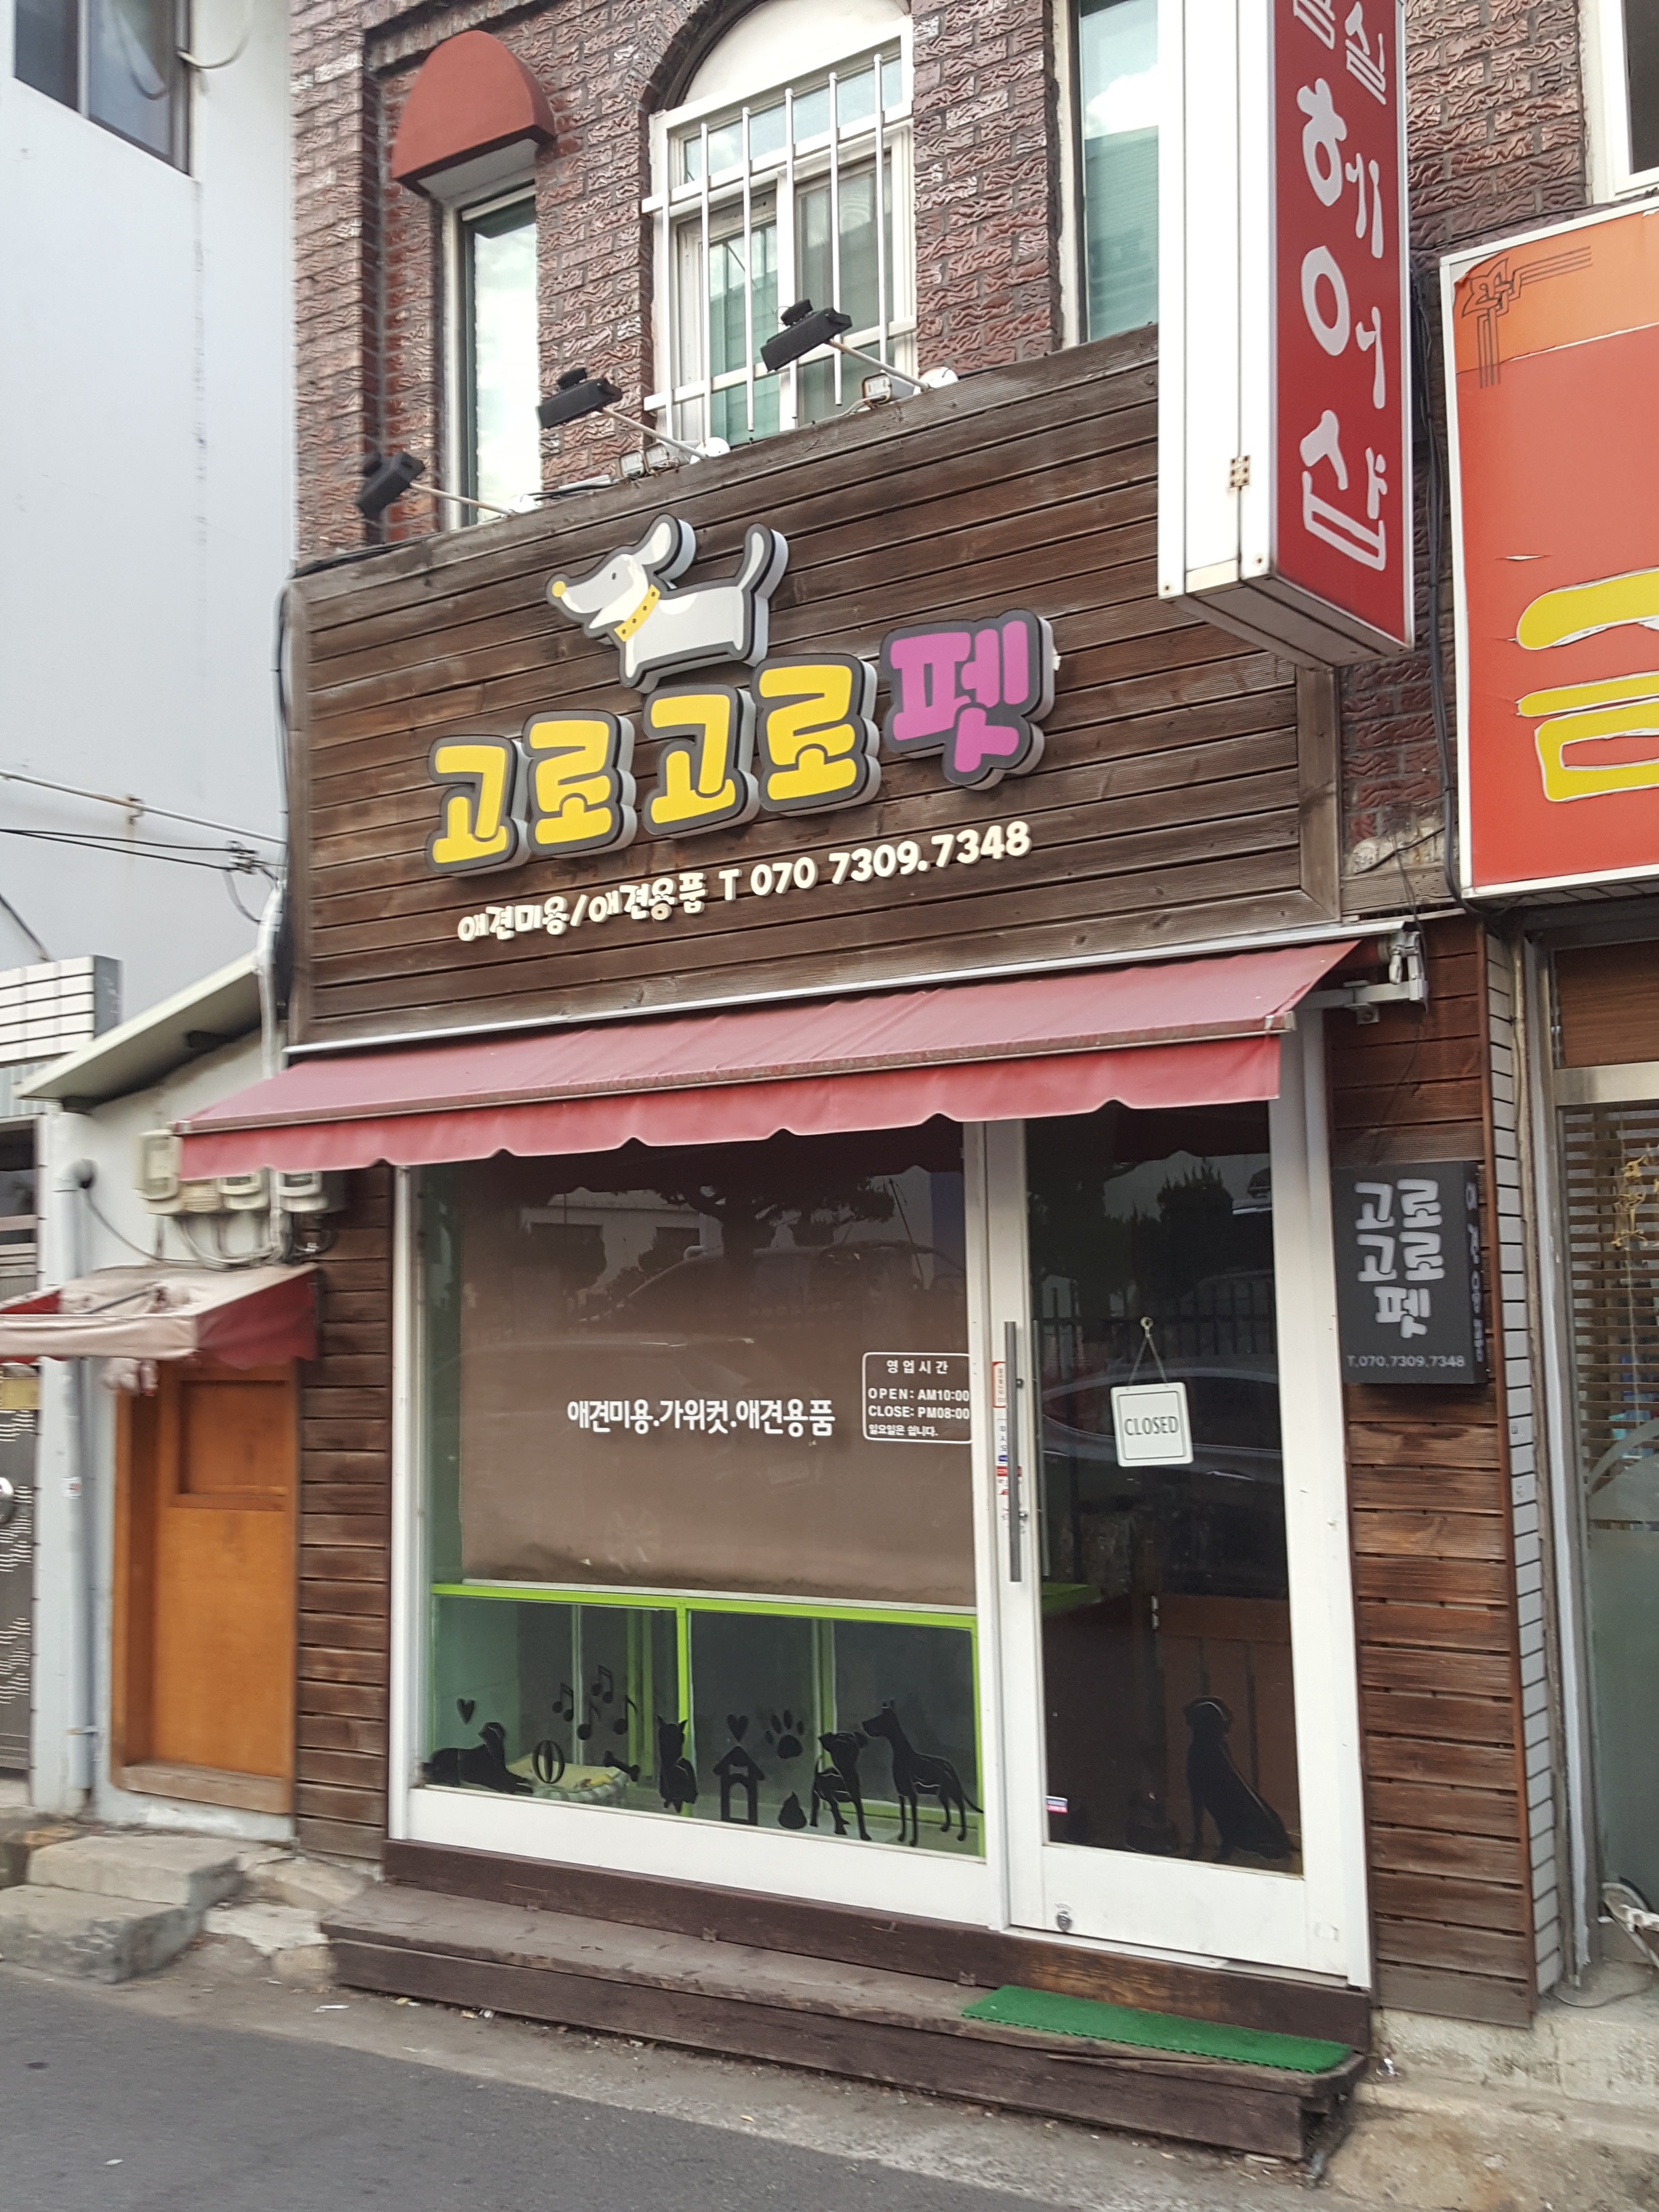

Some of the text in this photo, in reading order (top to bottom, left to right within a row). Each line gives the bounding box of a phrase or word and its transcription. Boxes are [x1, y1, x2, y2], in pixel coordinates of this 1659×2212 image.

[1296, 78, 1388, 572] 헤어샵
[457, 821, 1032, 942] 애견미용/애견용품 T 070 7309.7348
[1354, 1178, 1443, 1230] 고로
[1356, 1231, 1446, 1282] 고로
[1373, 1286, 1431, 1339] 펫
[867, 1387, 970, 1402] OPEN: AM10:00
[867, 1405, 970, 1420] CLOSE: PM08:00
[868, 1424, 905, 1436] 일요일은
[1124, 1415, 1179, 1437] CLOSED
